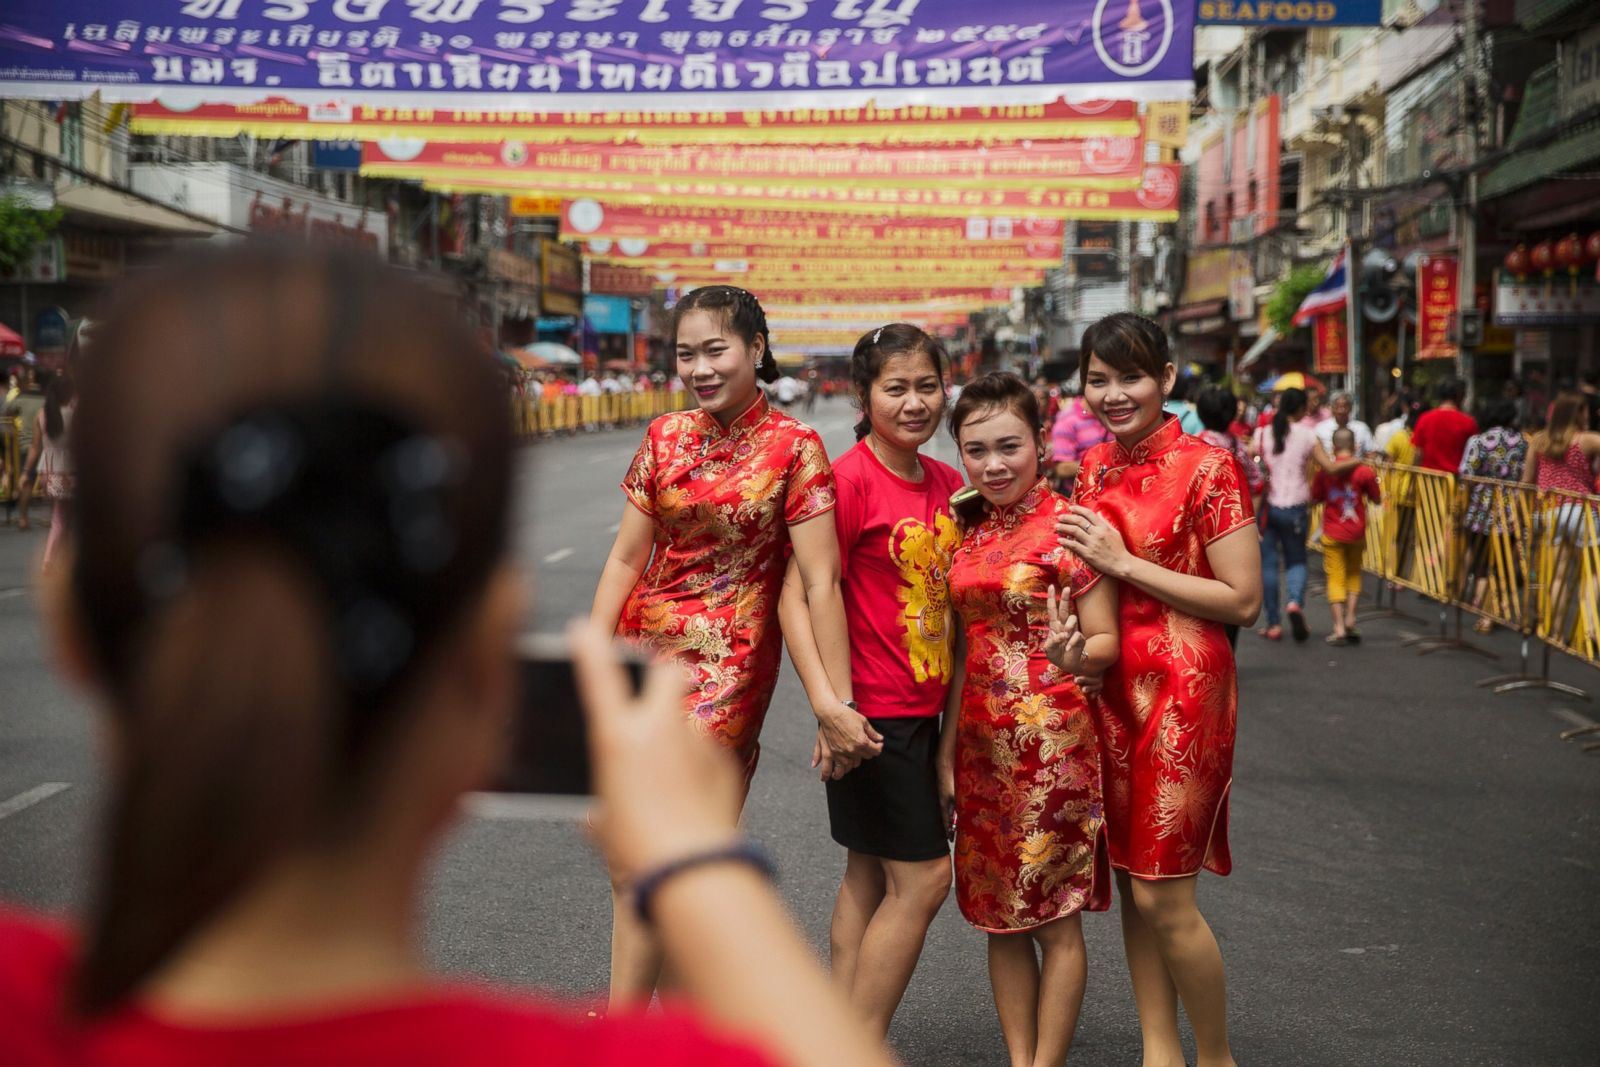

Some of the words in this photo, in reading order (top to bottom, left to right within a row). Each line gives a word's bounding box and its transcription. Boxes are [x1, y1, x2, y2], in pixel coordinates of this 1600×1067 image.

[1199, 2, 1337, 21] SEAFOOD
[419, 31, 474, 49] ๖๐
[494, 30, 640, 49] พรรษา
